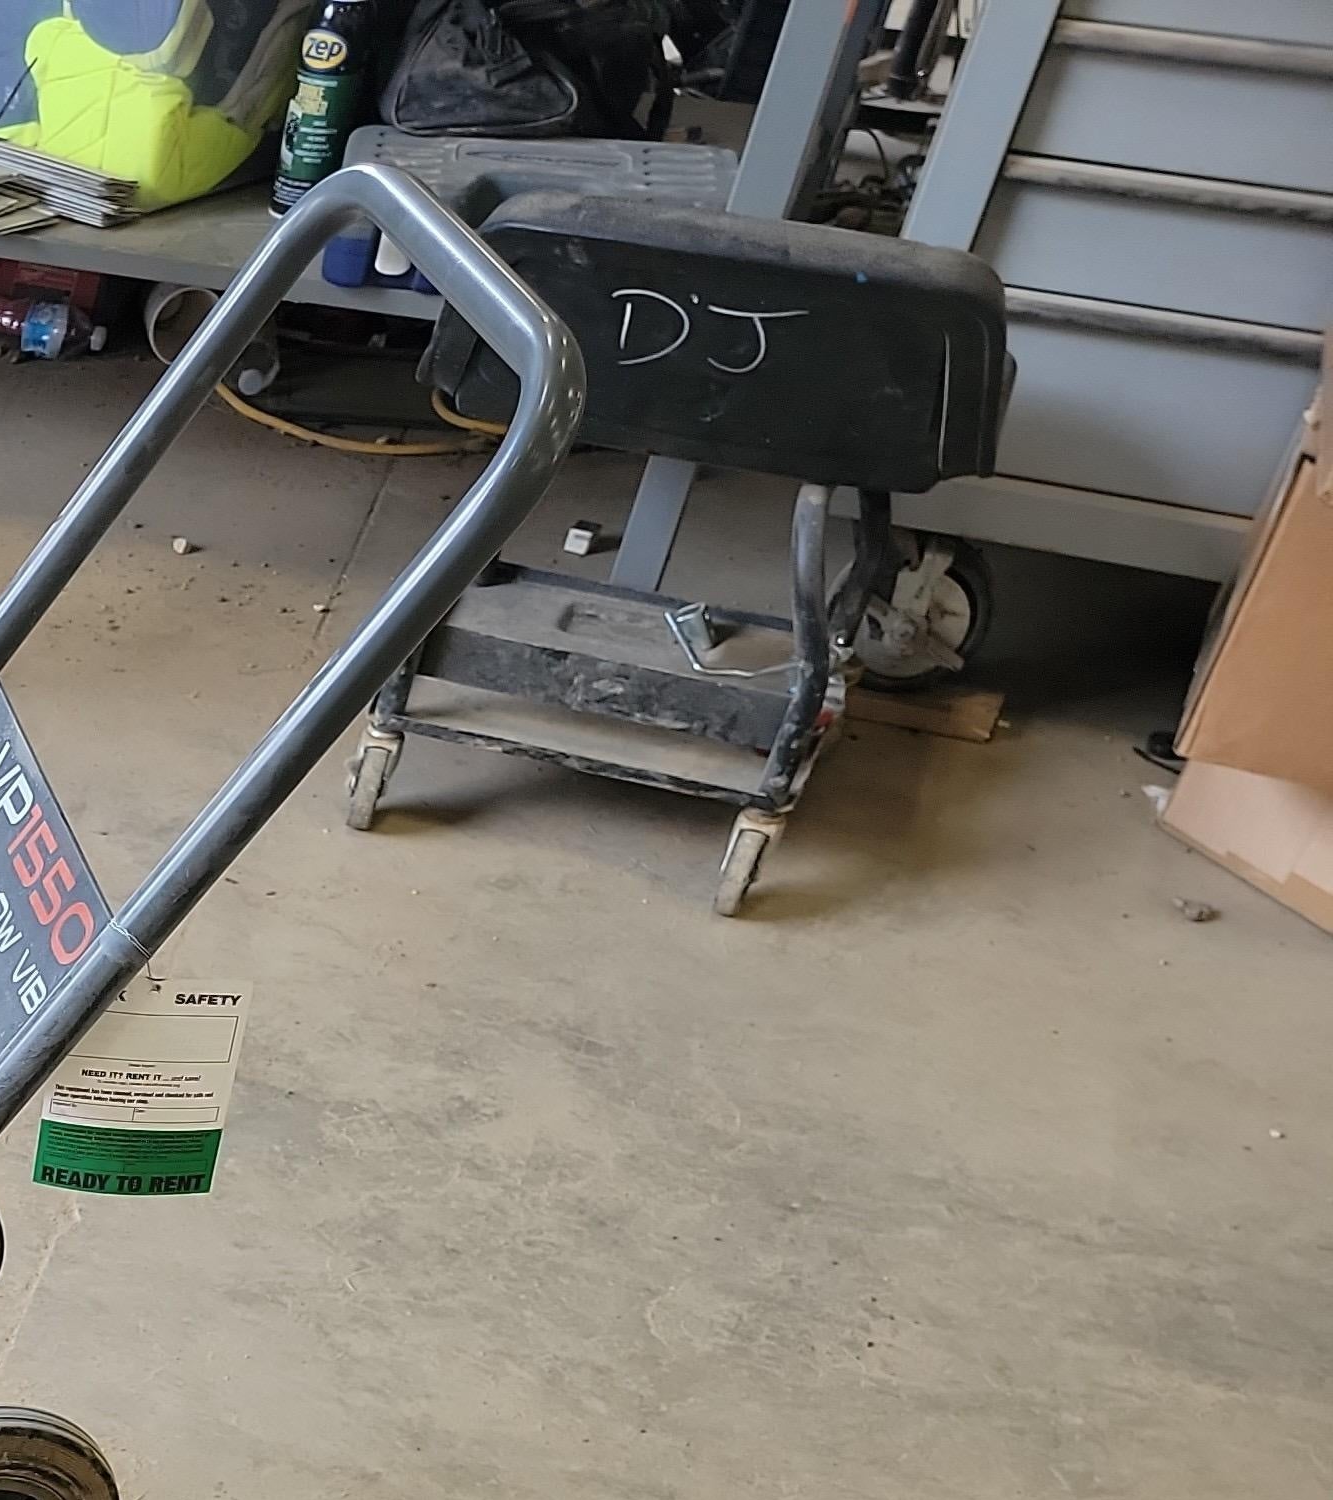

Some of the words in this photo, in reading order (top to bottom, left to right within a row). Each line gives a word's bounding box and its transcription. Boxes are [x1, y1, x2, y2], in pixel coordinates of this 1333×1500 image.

[12, 948, 47, 1015] VIB
[174, 993, 243, 1007] SAFETY
[81, 1069, 107, 1078] NEED
[109, 1071, 123, 1079] IT?
[125, 1072, 150, 1081] RENT
[41, 1164, 110, 1191] READY
[117, 1174, 142, 1191] TO
[149, 1173, 206, 1193] RENT
